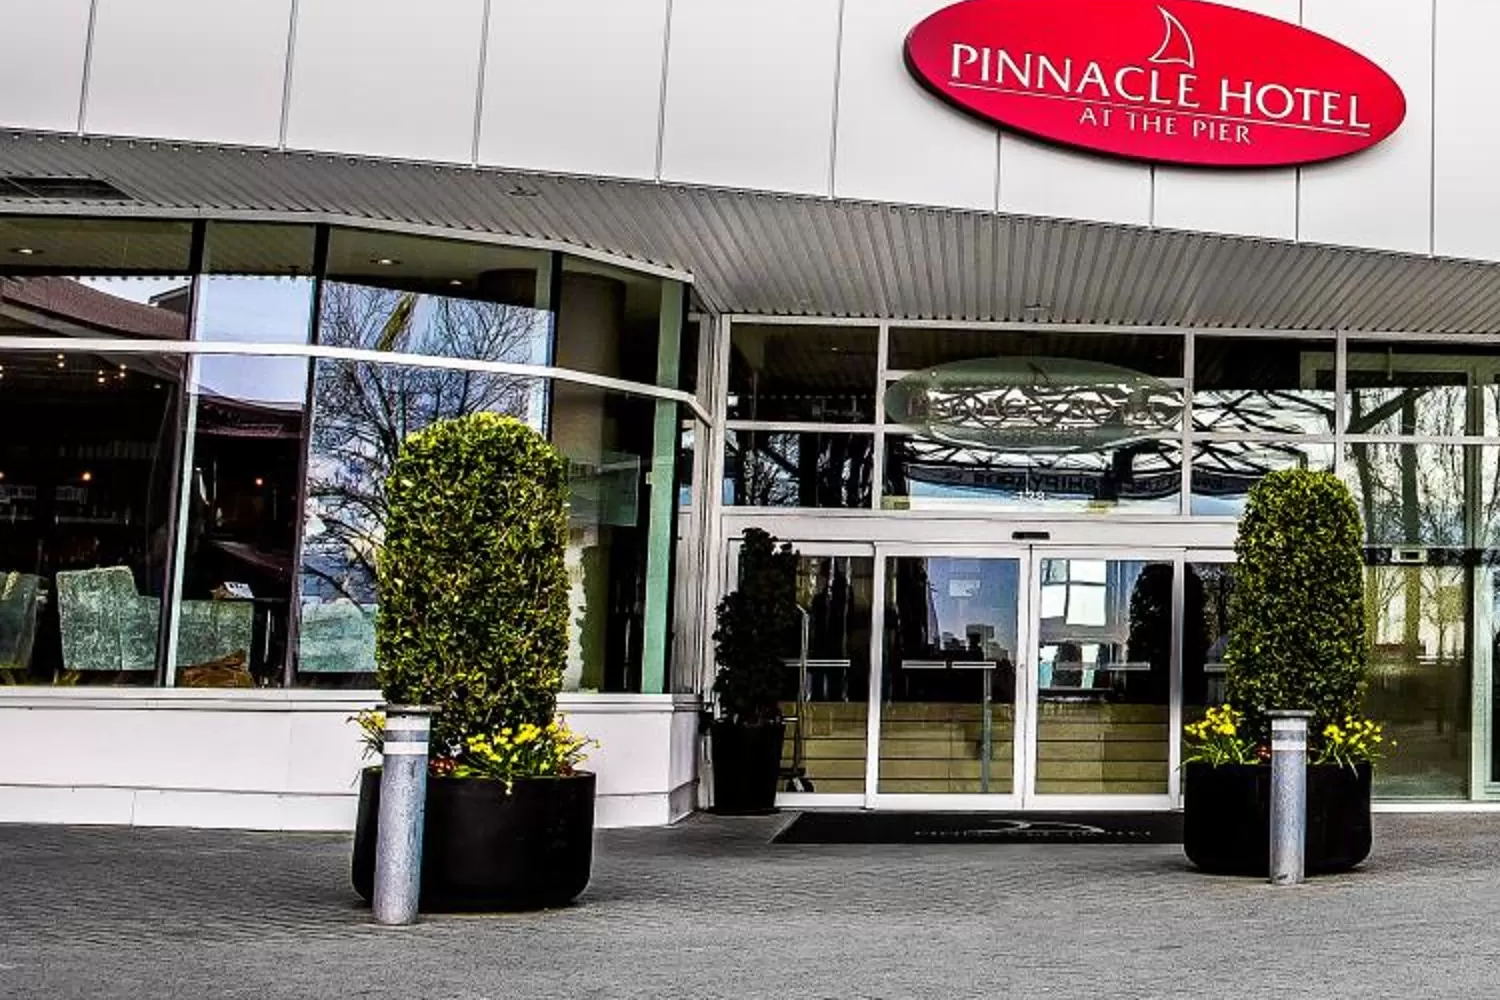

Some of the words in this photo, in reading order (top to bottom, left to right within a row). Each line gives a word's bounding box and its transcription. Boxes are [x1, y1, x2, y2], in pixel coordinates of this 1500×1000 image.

[951, 43, 1200, 108] PINNACLE
[1219, 78, 1371, 129] HOTEL
[1079, 106, 1112, 128] AT
[1126, 110, 1179, 136] THE
[1193, 118, 1252, 145] PIER
